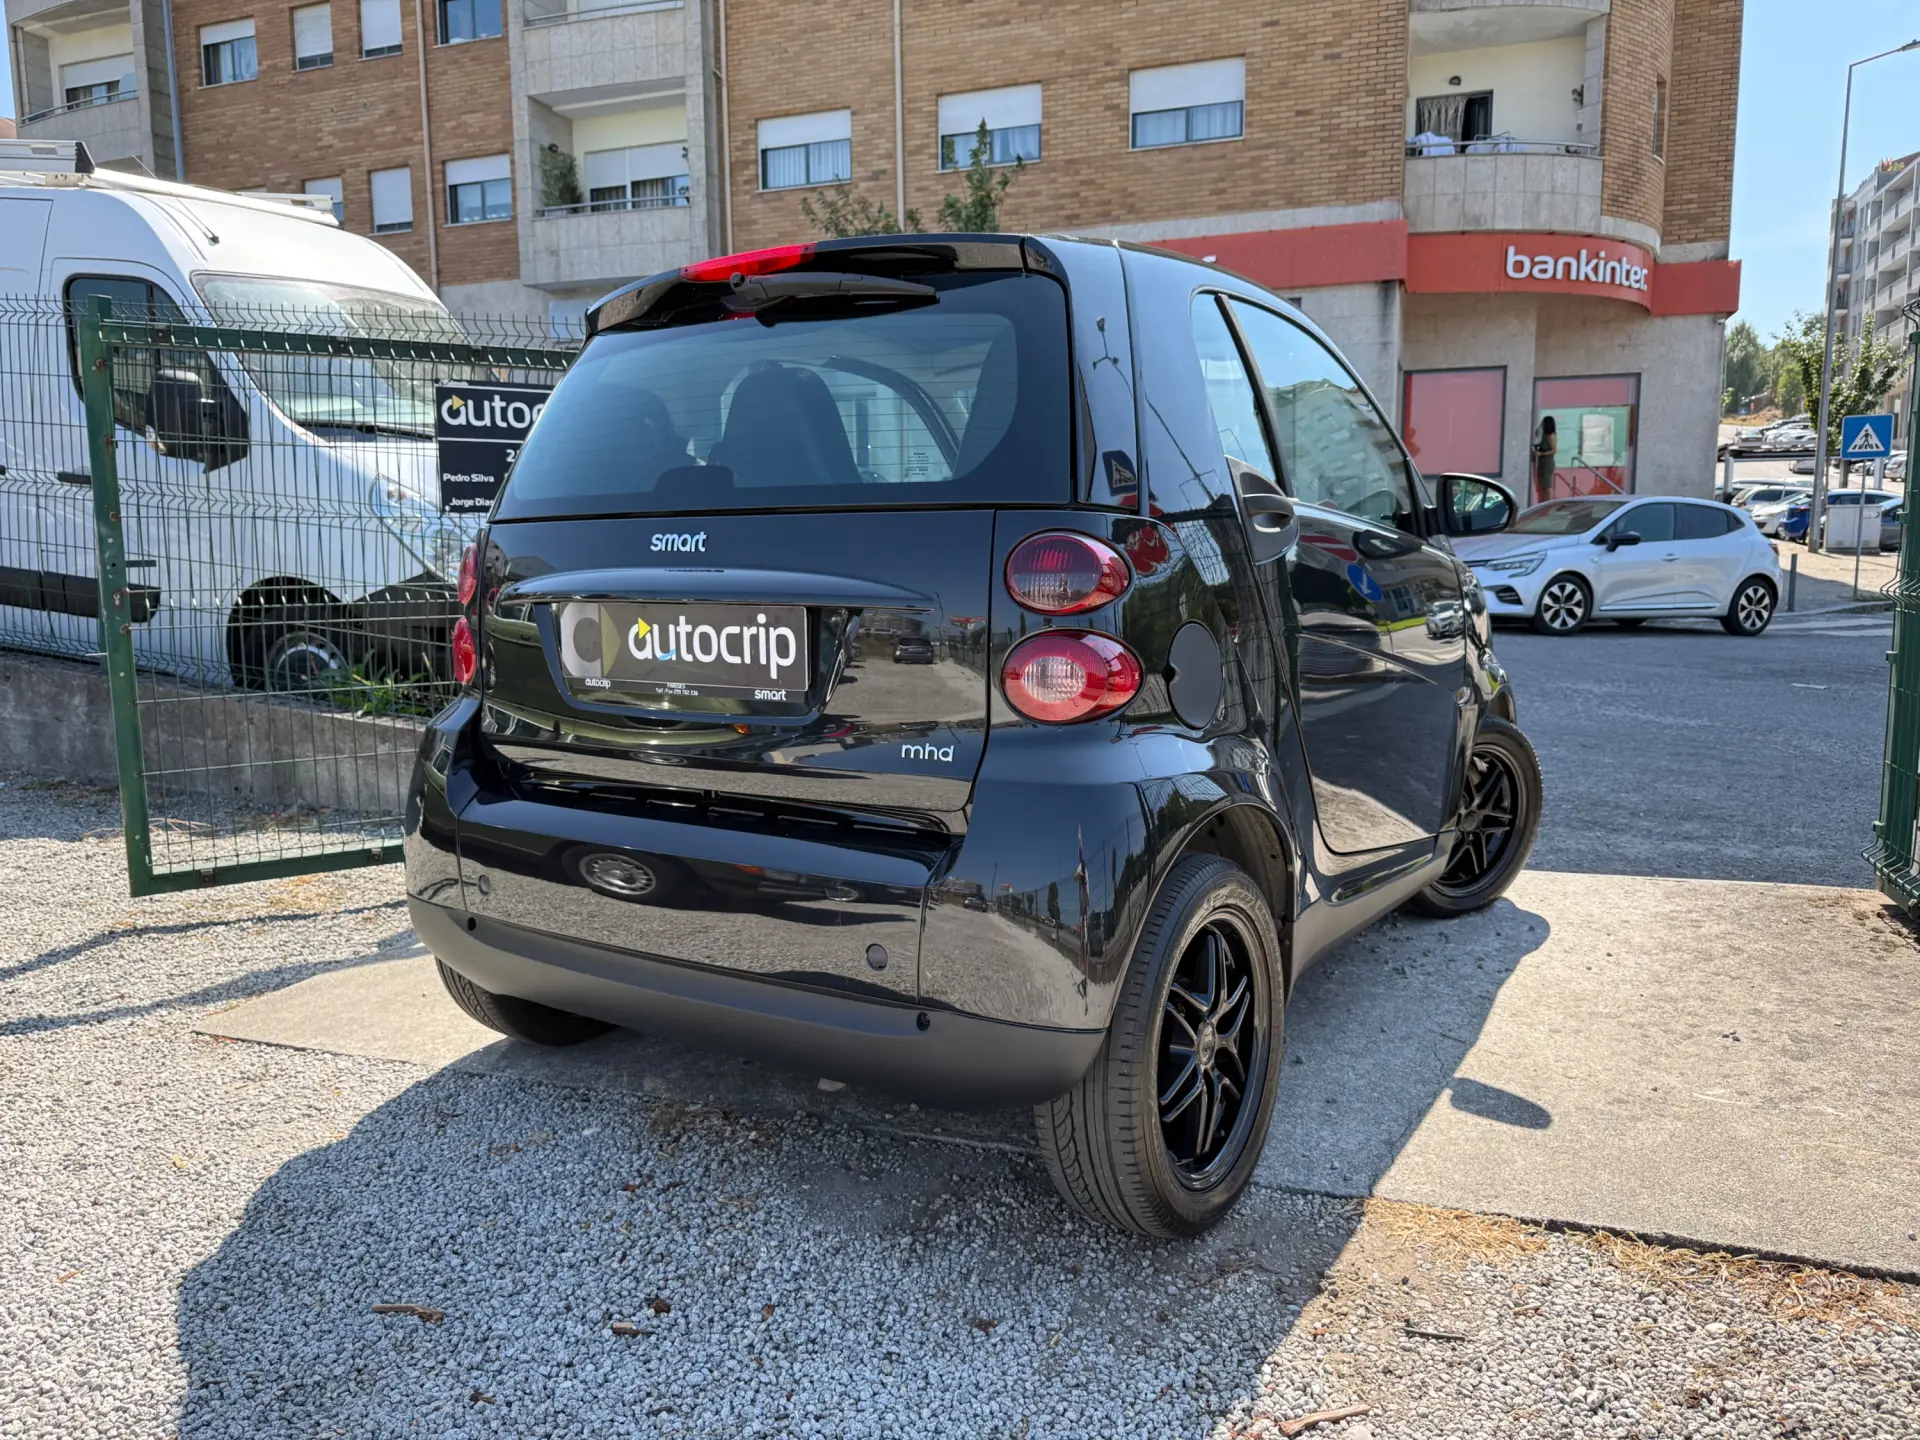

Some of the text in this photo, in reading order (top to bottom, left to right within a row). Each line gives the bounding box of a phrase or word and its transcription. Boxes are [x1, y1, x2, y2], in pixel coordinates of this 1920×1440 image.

[443, 473, 495, 482] Pedro Silva
[450, 497, 474, 508] Jorge
[650, 531, 707, 552] smart
[628, 613, 797, 680] autocrip
[755, 689, 787, 701] smart
[901, 743, 955, 762] mhd
